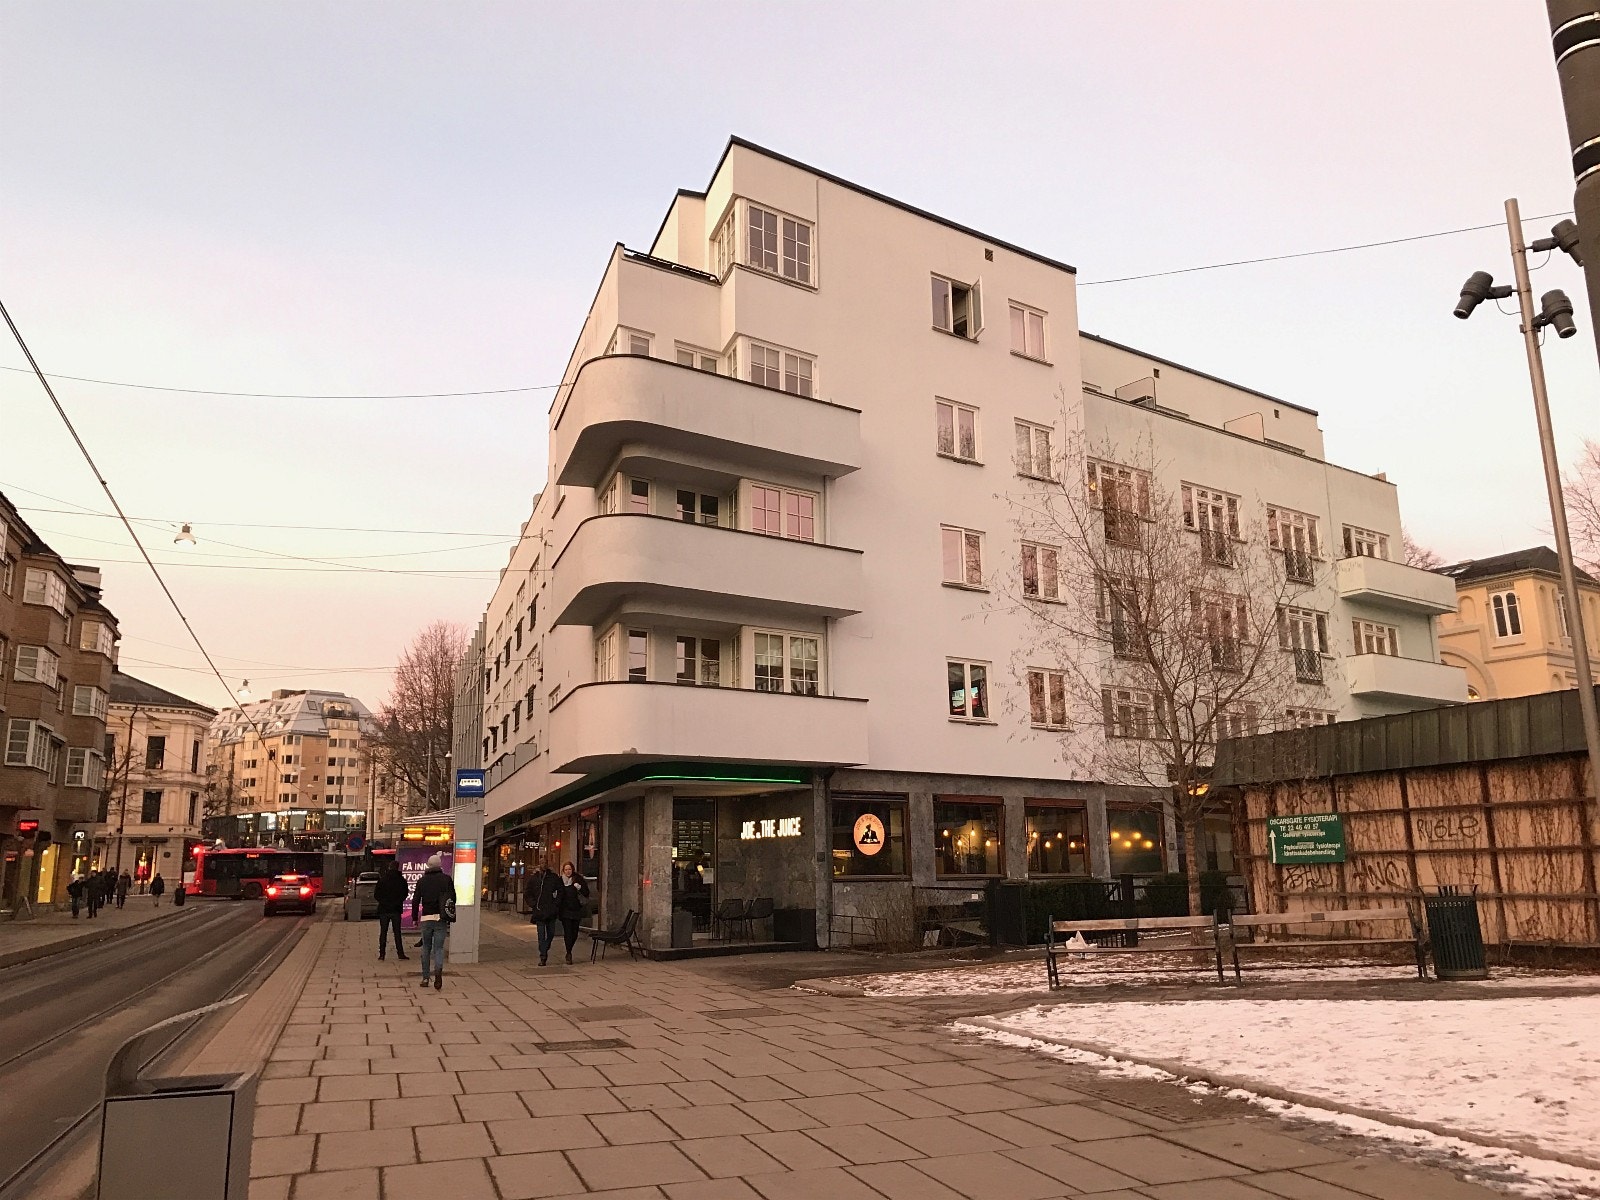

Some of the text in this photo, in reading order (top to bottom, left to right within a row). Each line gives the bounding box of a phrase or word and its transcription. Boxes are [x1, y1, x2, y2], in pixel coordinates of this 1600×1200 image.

[1303, 814, 1338, 822] FYSIOTERAPI
[741, 821, 756, 840] JOE
[760, 819, 776, 838] THE
[777, 816, 802, 837] JUICE
[402, 861, 413, 871] FÅ
